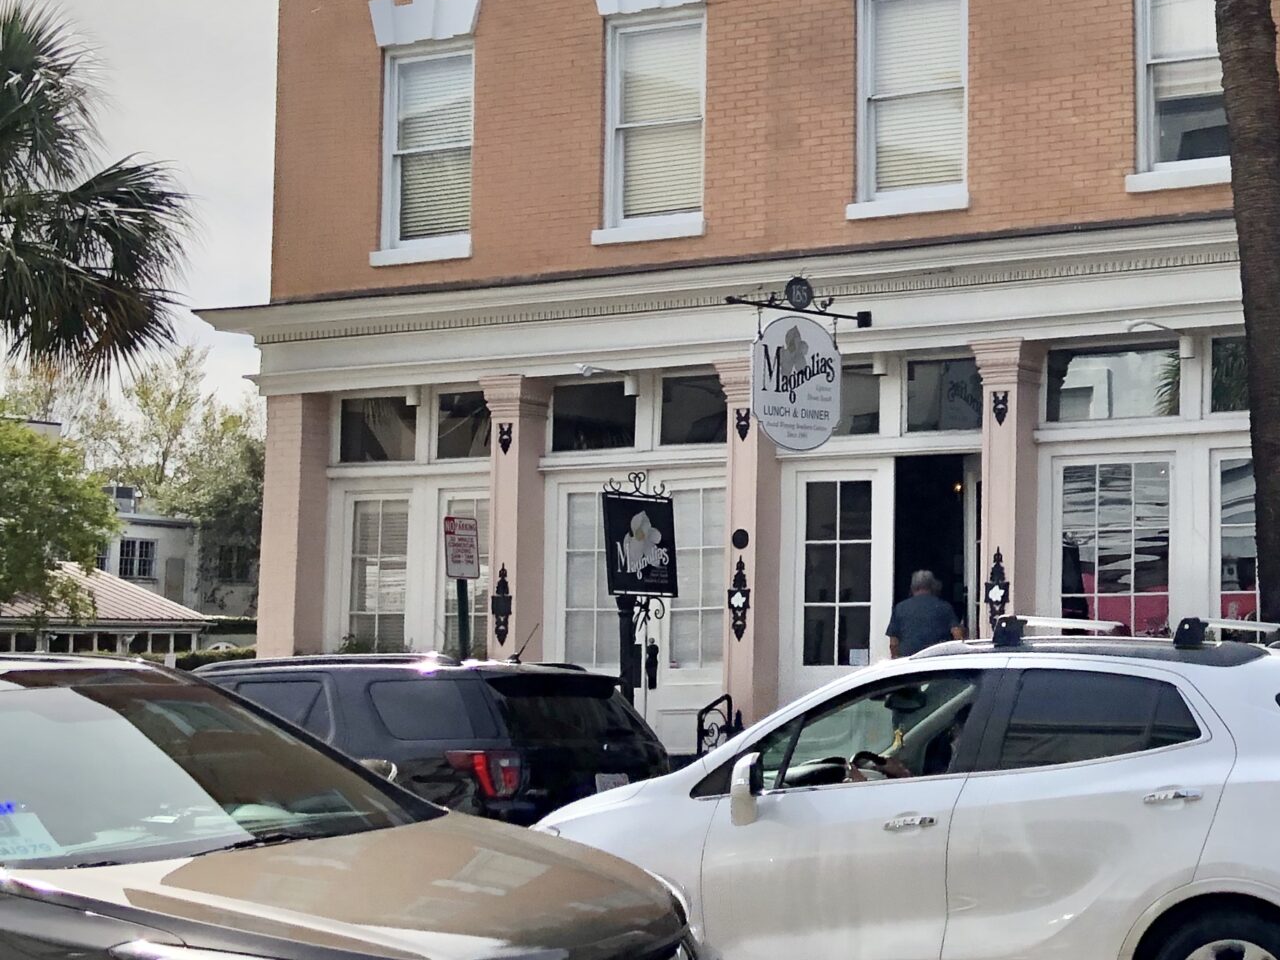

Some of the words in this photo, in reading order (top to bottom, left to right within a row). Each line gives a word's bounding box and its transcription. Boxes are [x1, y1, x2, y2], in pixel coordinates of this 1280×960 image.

[761, 343, 836, 405] Magnolias
[763, 404, 791, 418] LUNCH
[792, 407, 799, 419] &
[800, 408, 830, 421] DINNER
[445, 520, 455, 533] NO
[455, 521, 477, 531] PARKING
[616, 541, 670, 580] Magnolias
